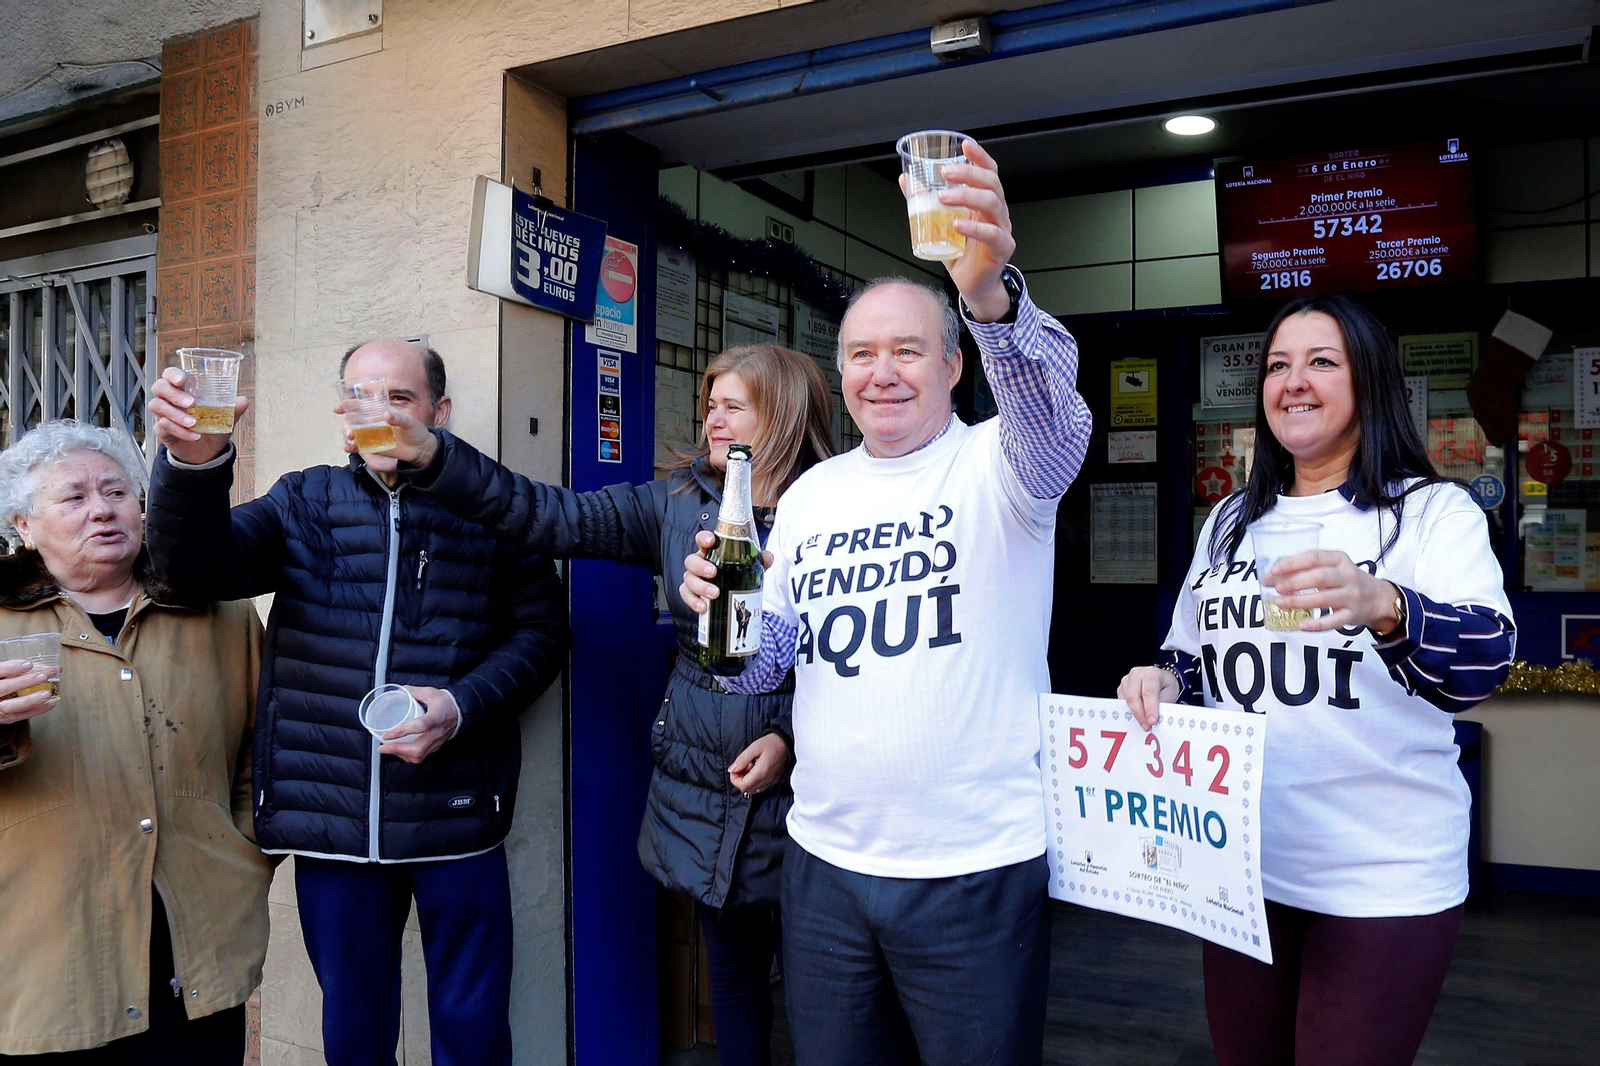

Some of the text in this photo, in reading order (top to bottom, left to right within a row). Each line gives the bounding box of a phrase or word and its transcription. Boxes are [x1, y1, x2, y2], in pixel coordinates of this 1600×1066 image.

[1311, 159, 1377, 174] 6 de Enero
[1311, 187, 1383, 203] Primer Premio
[1300, 197, 1396, 215] 2.000.000€ a la serie
[515, 212, 534, 232] ESTE
[1313, 214, 1383, 239] 57342
[515, 224, 579, 262] DECIMOS
[1376, 235, 1441, 250] Tercer Premio
[1252, 246, 1325, 263] Segundo Premio
[1369, 248, 1414, 260] 250.000€
[1421, 246, 1427, 255] la
[1428, 245, 1449, 255] serie
[516, 240, 578, 290] 3,00
[1251, 258, 1293, 270] 750.000€
[1301, 257, 1306, 265] la
[1307, 255, 1326, 266] serie
[1376, 258, 1443, 280] 26706
[1260, 270, 1312, 290] 21816
[543, 281, 576, 302] EUROS
[595, 304, 622, 320] spacio
[603, 318, 623, 333] humo
[1213, 342, 1244, 353] GRAN
[602, 358, 617, 368] VISA
[1223, 353, 1261, 367] 35.93
[604, 376, 615, 384] VISA
[825, 505, 953, 556] PREMIO
[791, 541, 957, 604] VENDIDO
[796, 576, 962, 677] AQUÍ
[451, 797, 472, 806] JBM
[1105, 789, 1228, 849] PREMIO
[1128, 870, 1153, 882] SORTEO
